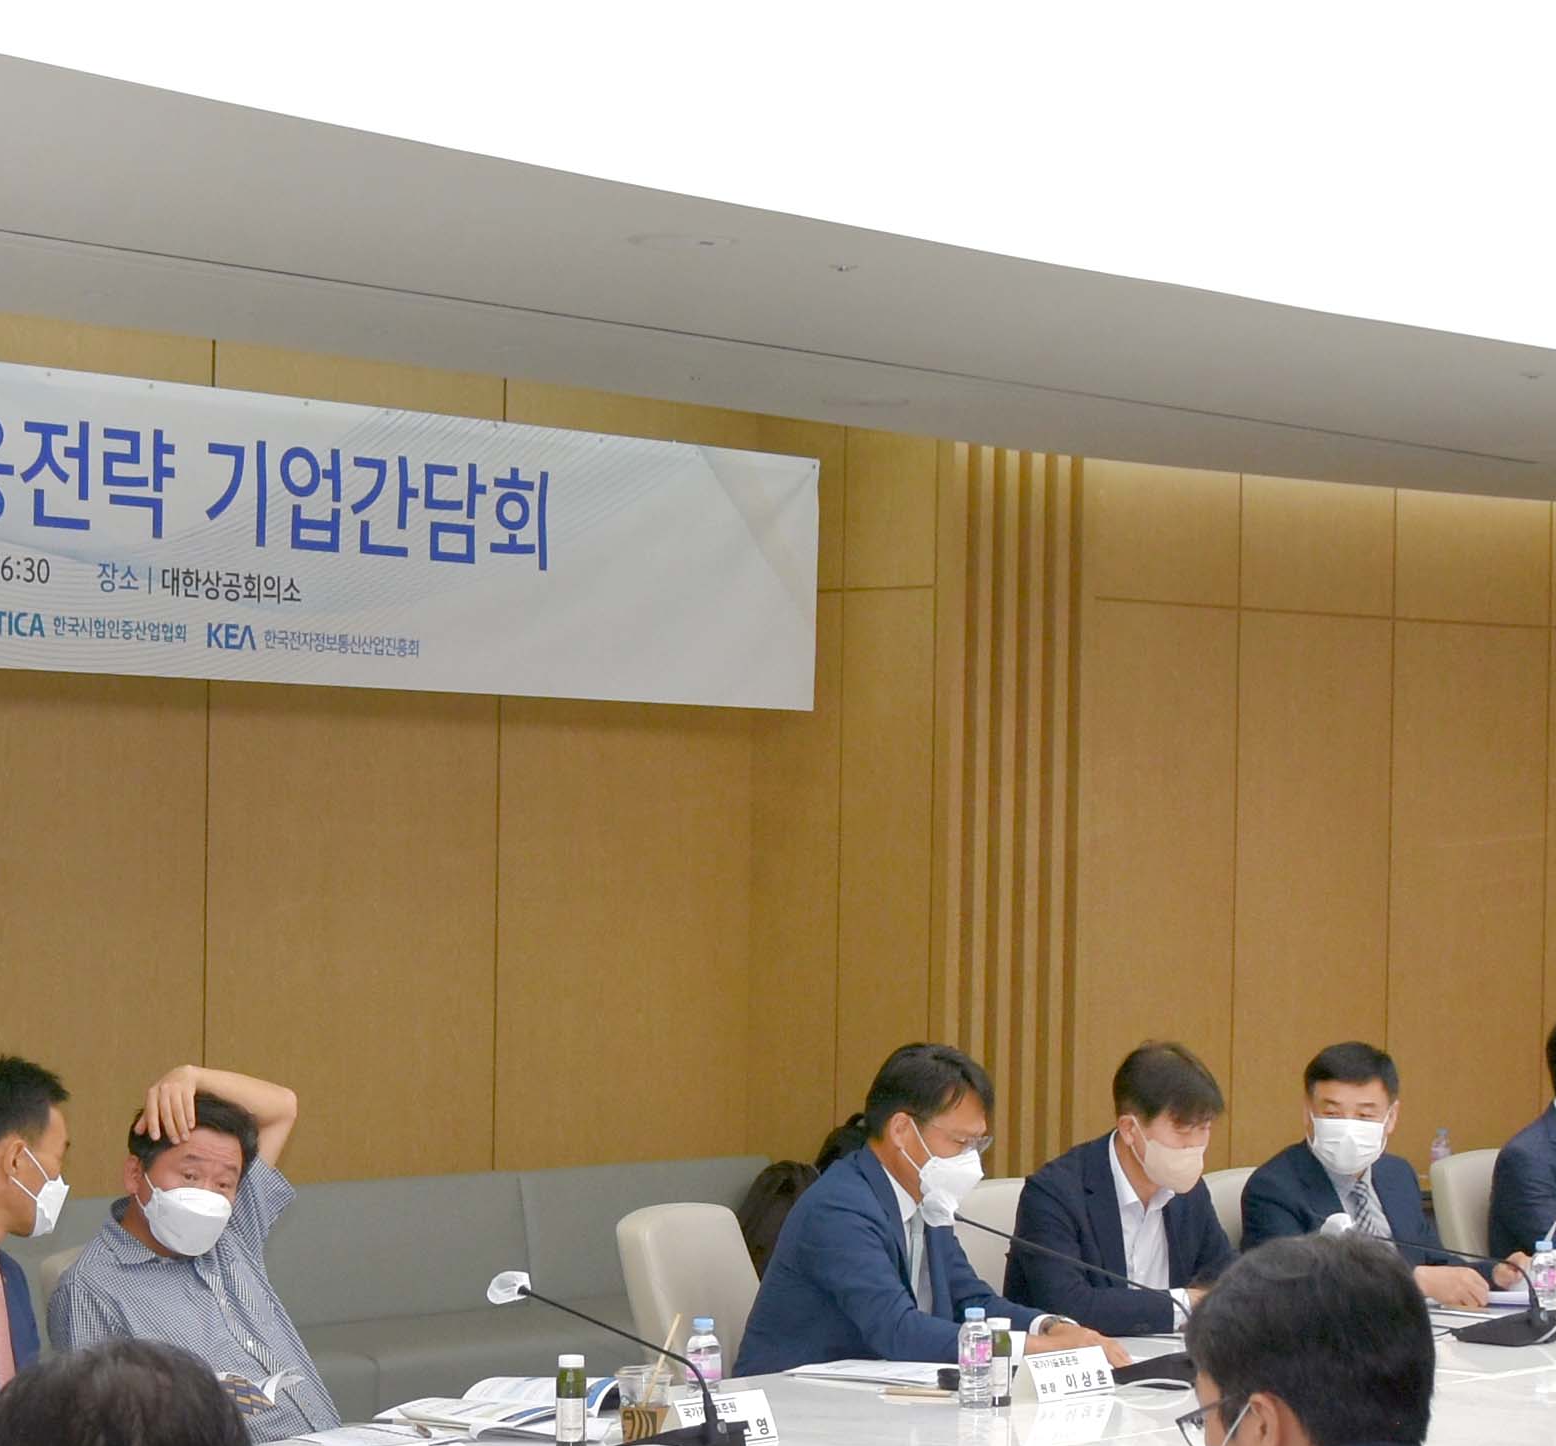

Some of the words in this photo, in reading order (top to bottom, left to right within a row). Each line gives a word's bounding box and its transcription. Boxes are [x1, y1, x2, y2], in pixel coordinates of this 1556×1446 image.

[203, 440, 549, 571] 기업간담회
[96, 562, 139, 594] 장소
[161, 568, 302, 604] 대한상공회의소
[52, 615, 188, 643] 한국시험인증산업협회
[263, 628, 420, 658] 한국전자정보통신산업진흥회
